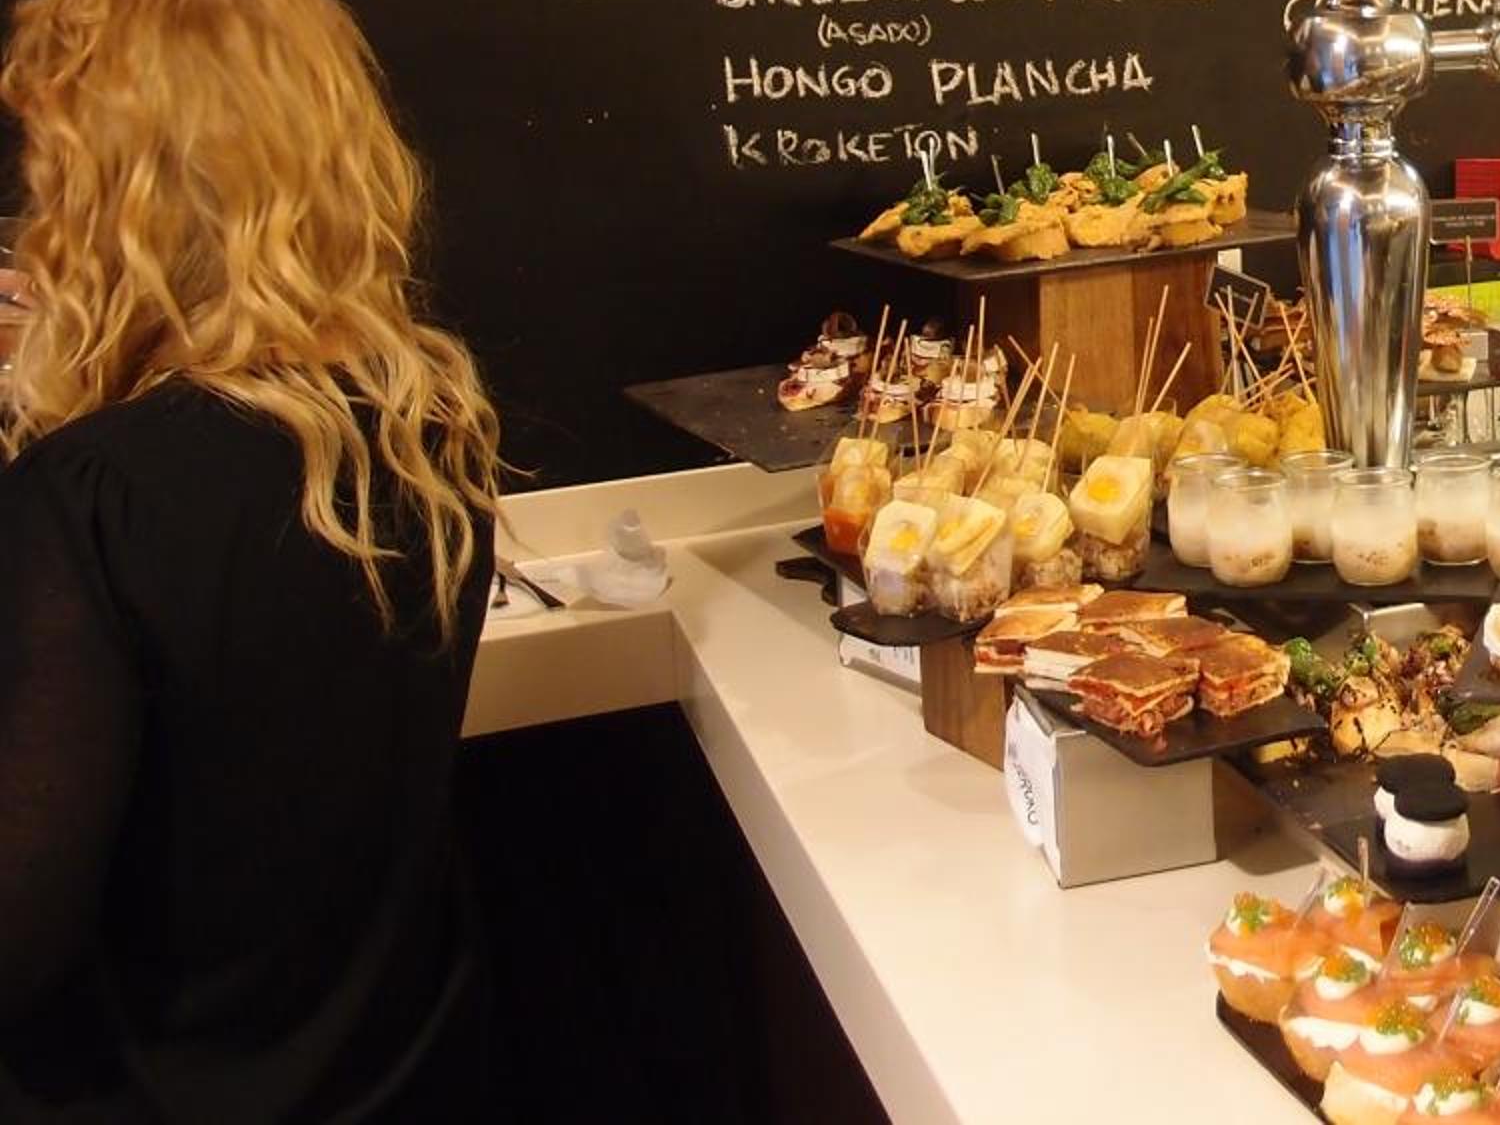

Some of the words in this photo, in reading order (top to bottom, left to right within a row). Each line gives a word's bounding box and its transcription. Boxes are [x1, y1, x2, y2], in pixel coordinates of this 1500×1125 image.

[817, 13, 932, 47] (ASADO)
[723, 56, 892, 102] HONGO
[930, 52, 1152, 105] PLANCHA
